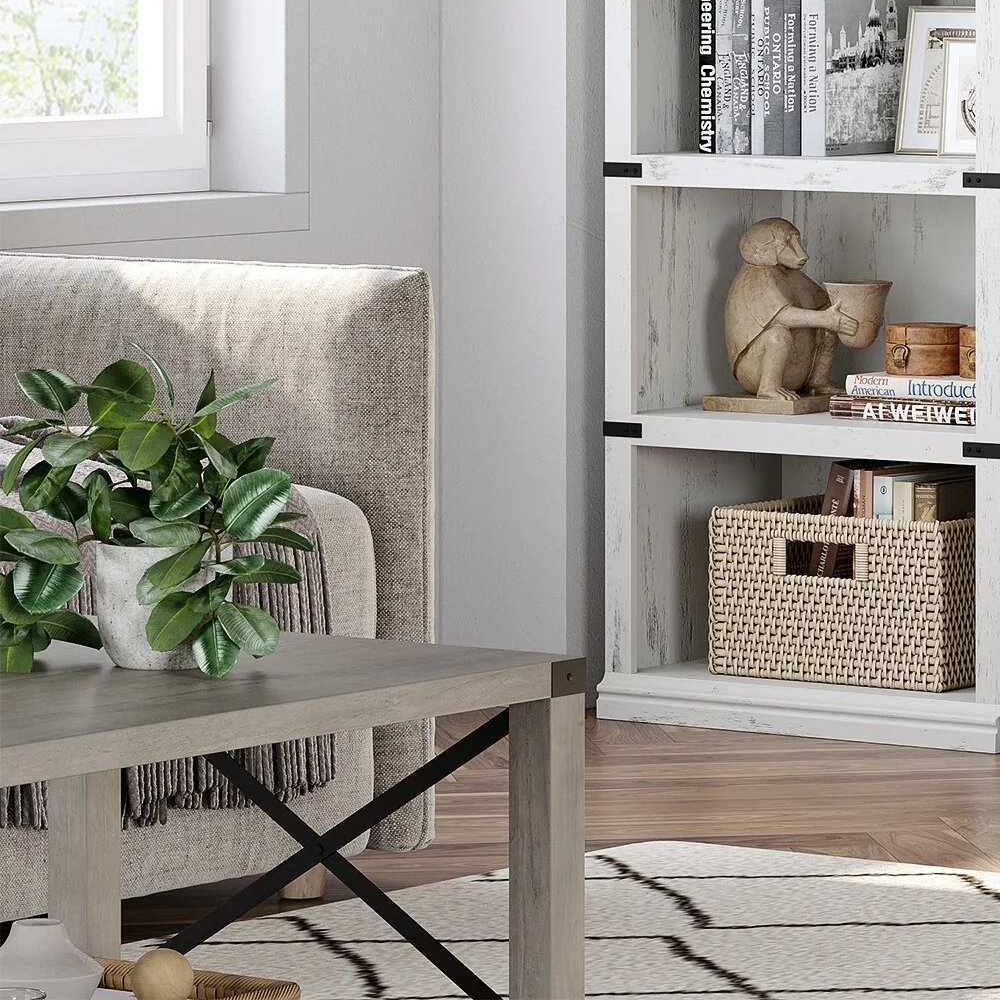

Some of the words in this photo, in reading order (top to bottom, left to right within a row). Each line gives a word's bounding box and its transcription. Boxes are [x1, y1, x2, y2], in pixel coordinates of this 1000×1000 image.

[787, 13, 797, 63] Forming
[807, 13, 819, 63] Forming
[757, 38, 765, 97] ONTARIO
[772, 32, 782, 95] ONTARIO
[699, 64, 716, 153] Chemistry
[787, 74, 797, 113] Nation
[808, 75, 819, 113] Nation
[851, 385, 896, 396] American
[854, 375, 889, 386] Modern
